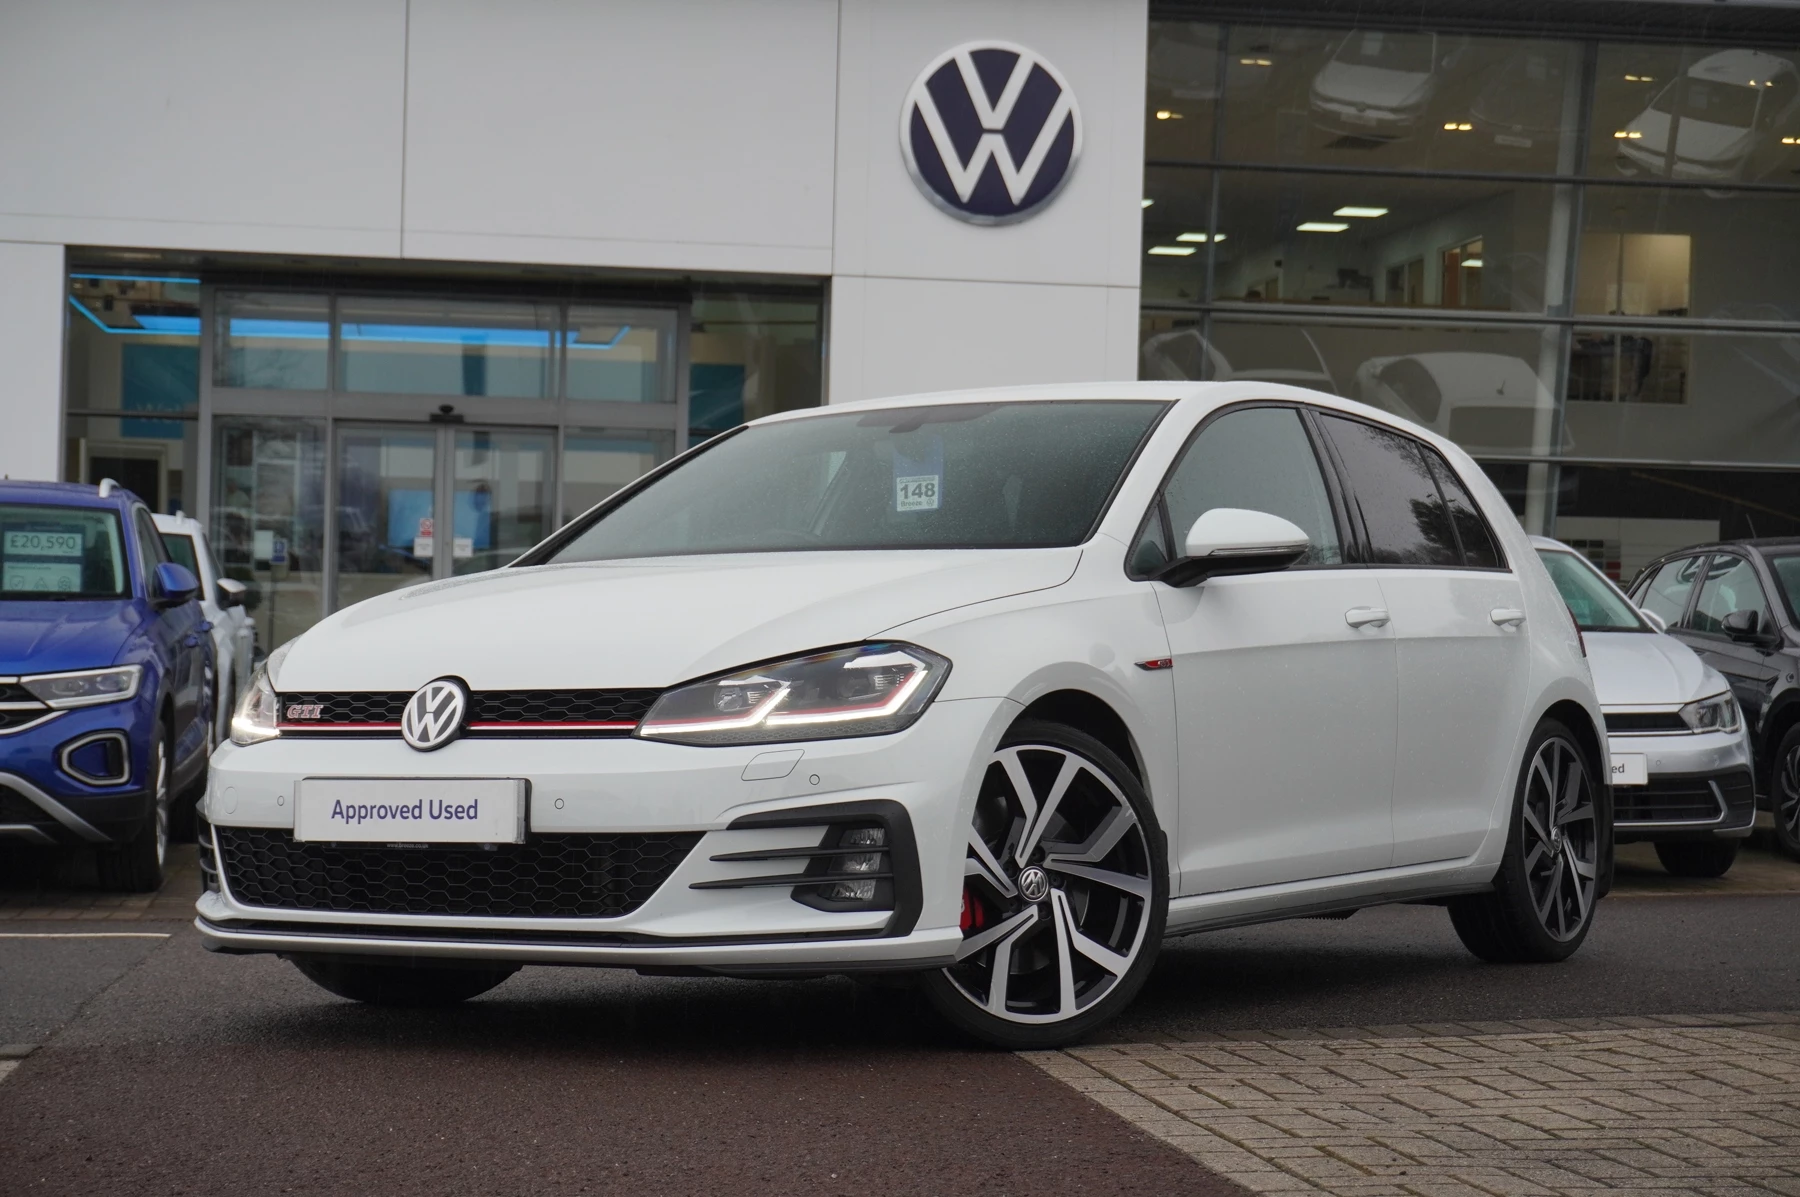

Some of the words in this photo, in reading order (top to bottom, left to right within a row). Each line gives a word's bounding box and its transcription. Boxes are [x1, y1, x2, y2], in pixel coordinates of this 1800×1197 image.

[905, 45, 1076, 207] VW
[900, 482, 935, 499] 148
[10, 534, 76, 550] £20,590
[287, 704, 324, 719] GTI
[403, 682, 463, 747] VW
[1611, 763, 1625, 774] ed
[331, 799, 423, 824] Approved
[429, 798, 478, 820] Used
